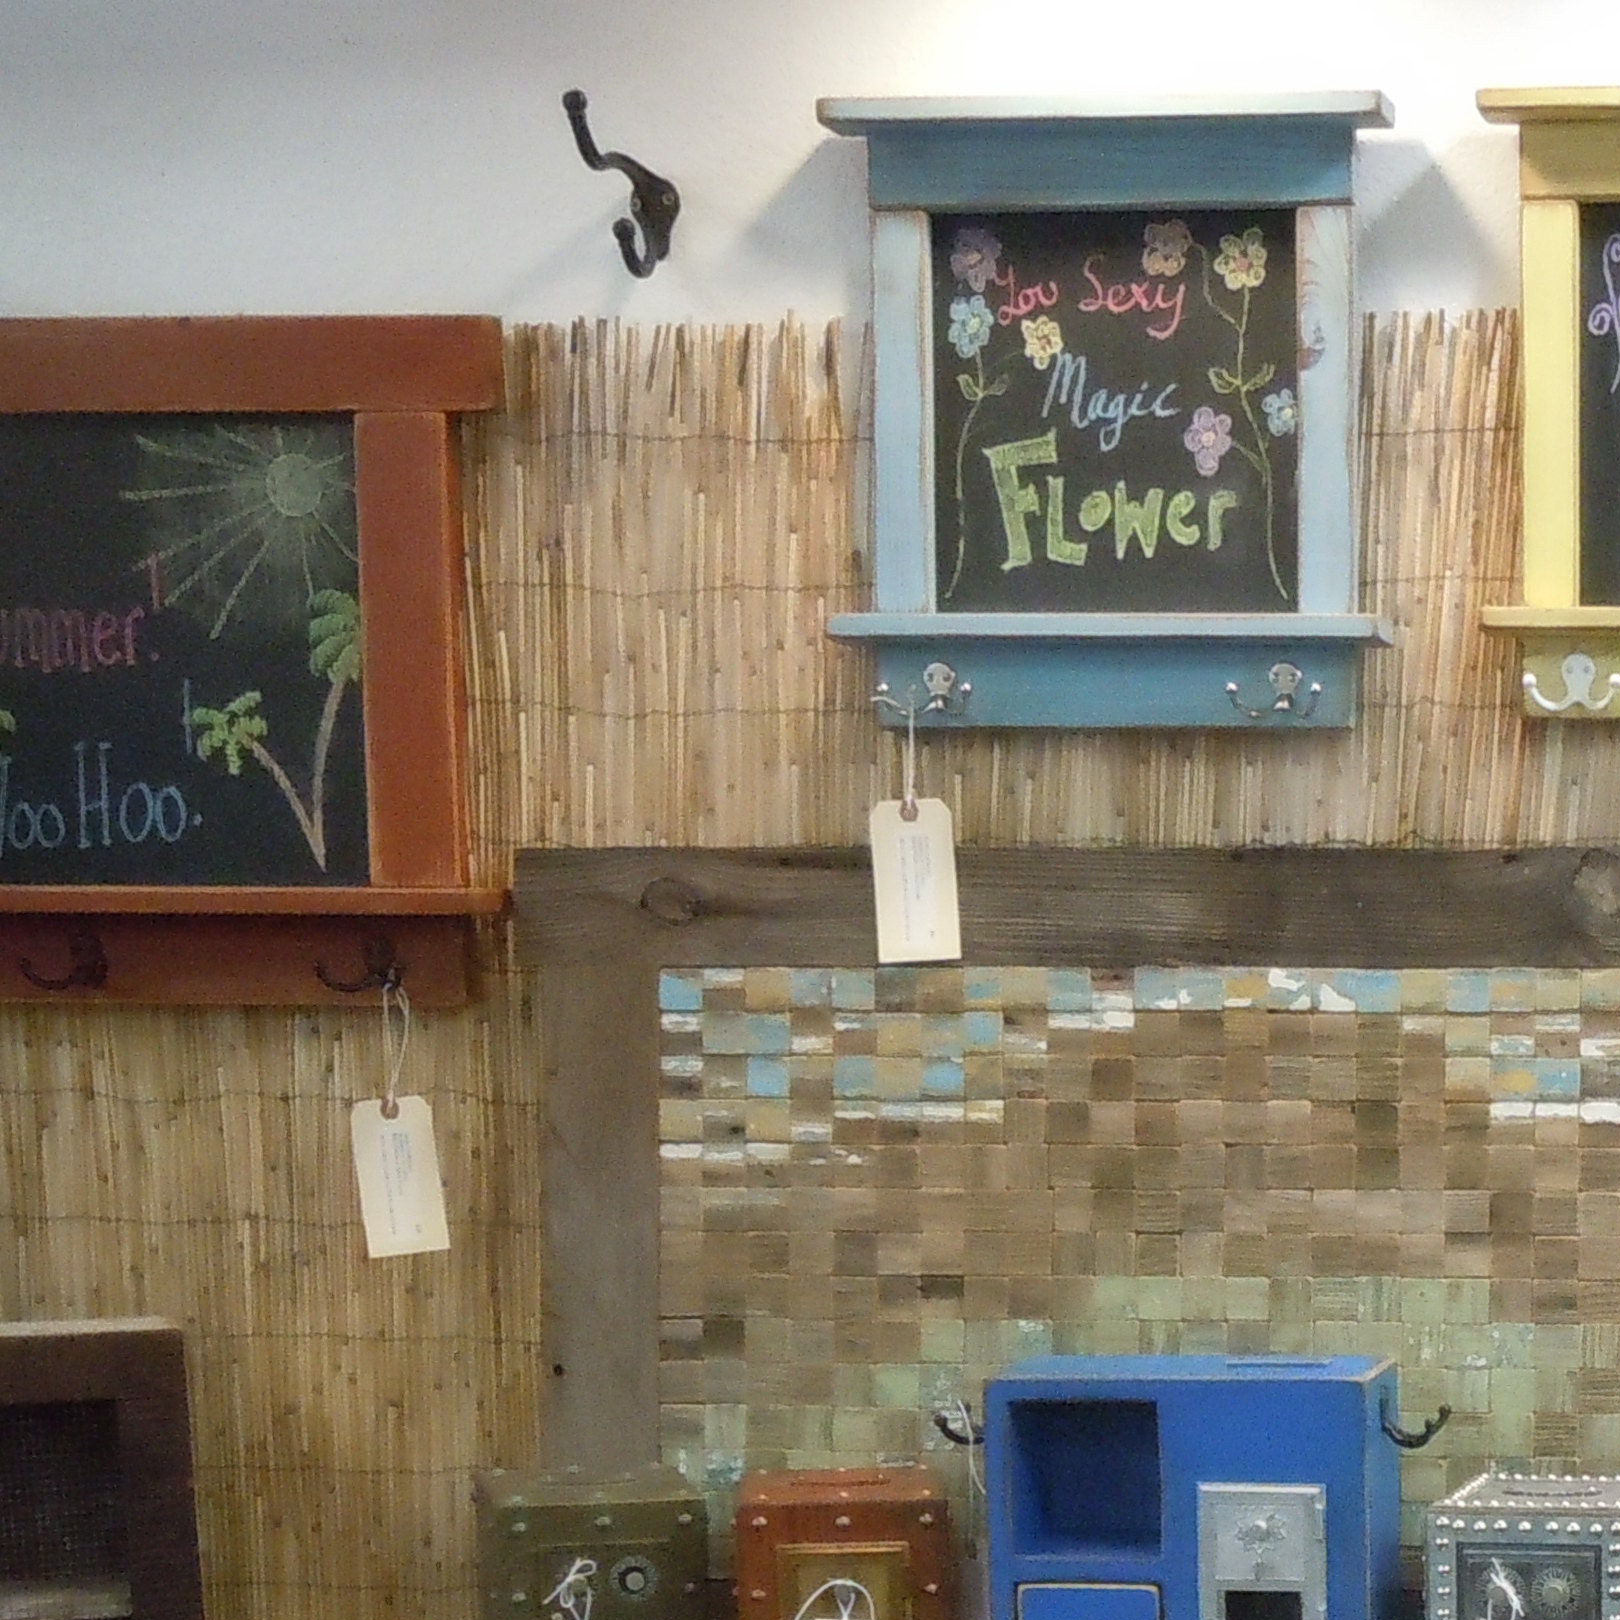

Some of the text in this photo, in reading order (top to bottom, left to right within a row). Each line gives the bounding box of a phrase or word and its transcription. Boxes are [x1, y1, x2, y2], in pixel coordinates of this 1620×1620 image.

[994, 254, 1186, 340] You Sexy
[1042, 352, 1182, 452] Magic
